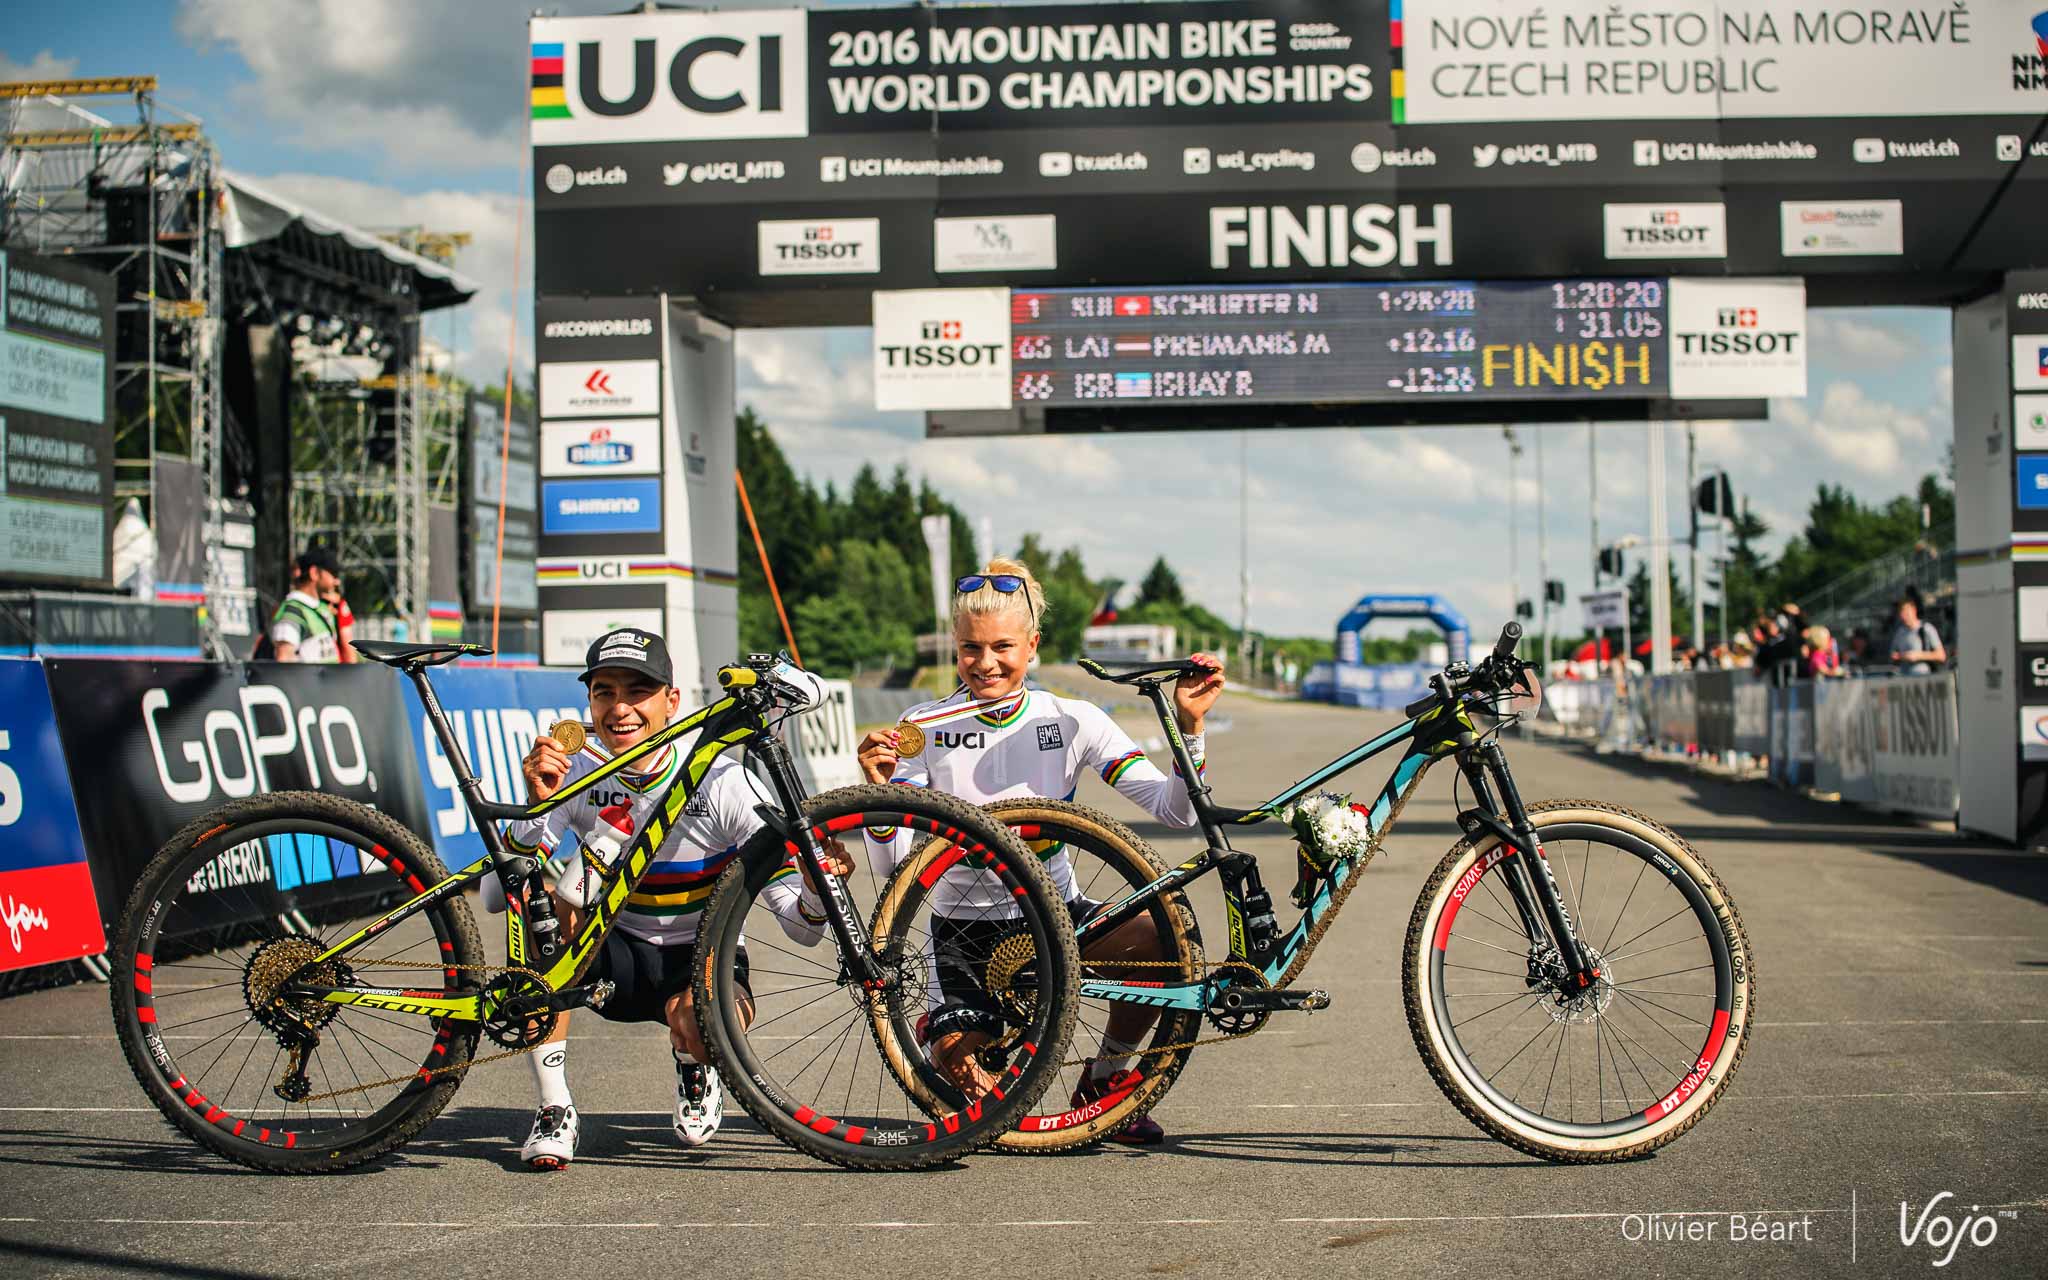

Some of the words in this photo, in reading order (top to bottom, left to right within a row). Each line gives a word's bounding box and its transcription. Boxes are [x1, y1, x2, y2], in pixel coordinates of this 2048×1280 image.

[1432, 7, 1548, 50] NOVÉ
[1564, 3, 1707, 47] MĚSTO
[1723, 11, 1780, 44] NA
[1794, 0, 1970, 44] MORAVĚ
[829, 29, 919, 66] 2016
[930, 22, 1170, 64] MOUNTAIN
[1181, 19, 1276, 58] BIKE
[1289, 37, 1352, 51] COUNTRY
[579, 35, 782, 117] UCI
[1432, 62, 1569, 97] CZECH
[1586, 58, 1779, 95] REPUBLIC
[828, 72, 990, 115] WORLD
[1001, 64, 1372, 109] CHAMPIONSHIPS
[1383, 148, 1436, 166] uci.ch
[1501, 144, 1597, 167] @UCI_MTB
[1663, 143, 1694, 161] UCI
[1697, 141, 1817, 160] Mountainbike
[1889, 139, 1959, 158] tv.uci.ch
[850, 159, 881, 176] UCI
[884, 155, 1003, 177] Mountainbike
[1075, 150, 1147, 171] tv.uci.ch
[1217, 150, 1315, 171] uci_cycling
[576, 169, 627, 186] uci.ch
[691, 161, 785, 184] @UCI_MTB
[1210, 204, 1452, 270] FINISH
[1622, 226, 1709, 244] TISSOT
[776, 243, 862, 260] TISSOT
[545, 319, 652, 337] #XCOWORLDS
[1676, 333, 1800, 354] TISSOT
[881, 345, 1004, 367] TISSOT
[1483, 341, 1650, 390] FINISH
[582, 561, 622, 579] UCI
[944, 732, 985, 749] UCI
[1039, 724, 1061, 744] SMS
[1486, 847, 1504, 868] DT
[1453, 861, 1483, 902] SWISS
[151, 900, 162, 916] DT
[824, 873, 844, 900] DT
[837, 904, 865, 953] SWISS
[141, 916, 155, 940] SWISS
[356, 998, 462, 1019] SCOTT
[1081, 988, 1181, 1009] SCOTT
[752, 1073, 766, 1087] DT
[763, 1085, 786, 1107] SWISS
[1660, 1091, 1681, 1114] DT
[1681, 1057, 1712, 1097] SWISS
[1039, 1116, 1062, 1130] DT
[1065, 1101, 1103, 1127] SWISS
[873, 1138, 909, 1146] 1200
